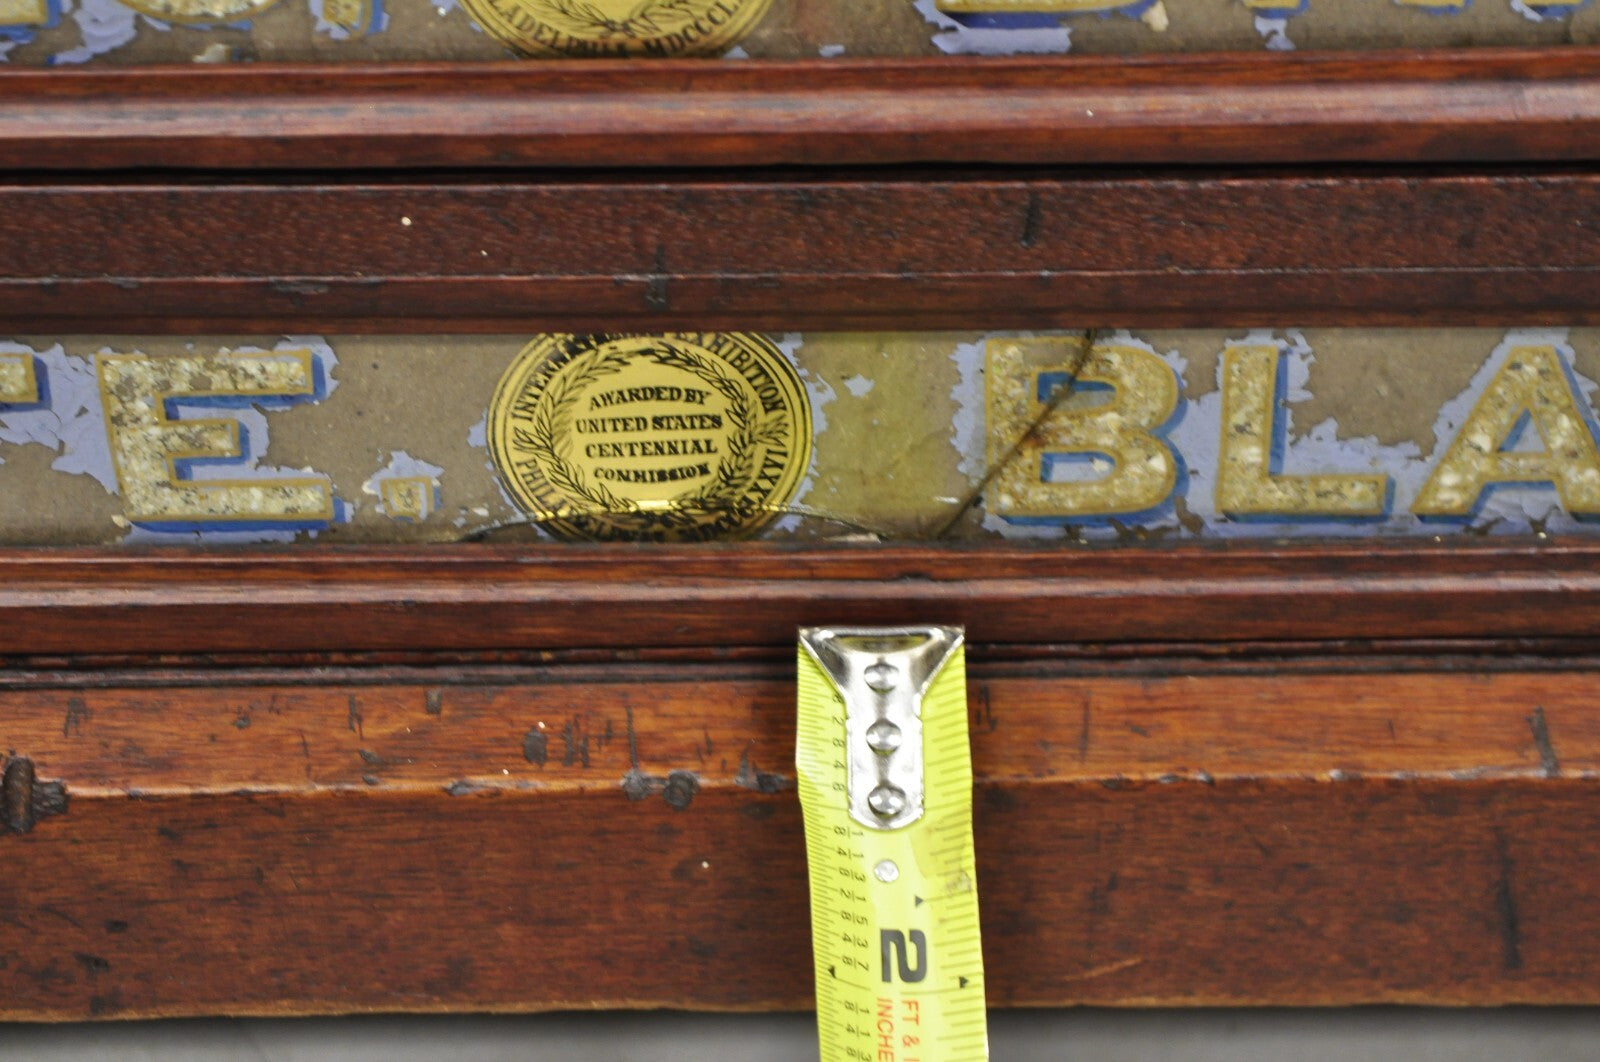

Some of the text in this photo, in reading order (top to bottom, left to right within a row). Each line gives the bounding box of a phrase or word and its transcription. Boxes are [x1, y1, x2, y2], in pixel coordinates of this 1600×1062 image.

[590, 386, 712, 411] AWARDED BY
[575, 413, 723, 433] UNITED STATES
[585, 438, 718, 459] CENTENNIAL
[594, 462, 711, 483] COMMISSION
[880, 928, 927, 983] 2
[901, 999, 920, 1026] FT
